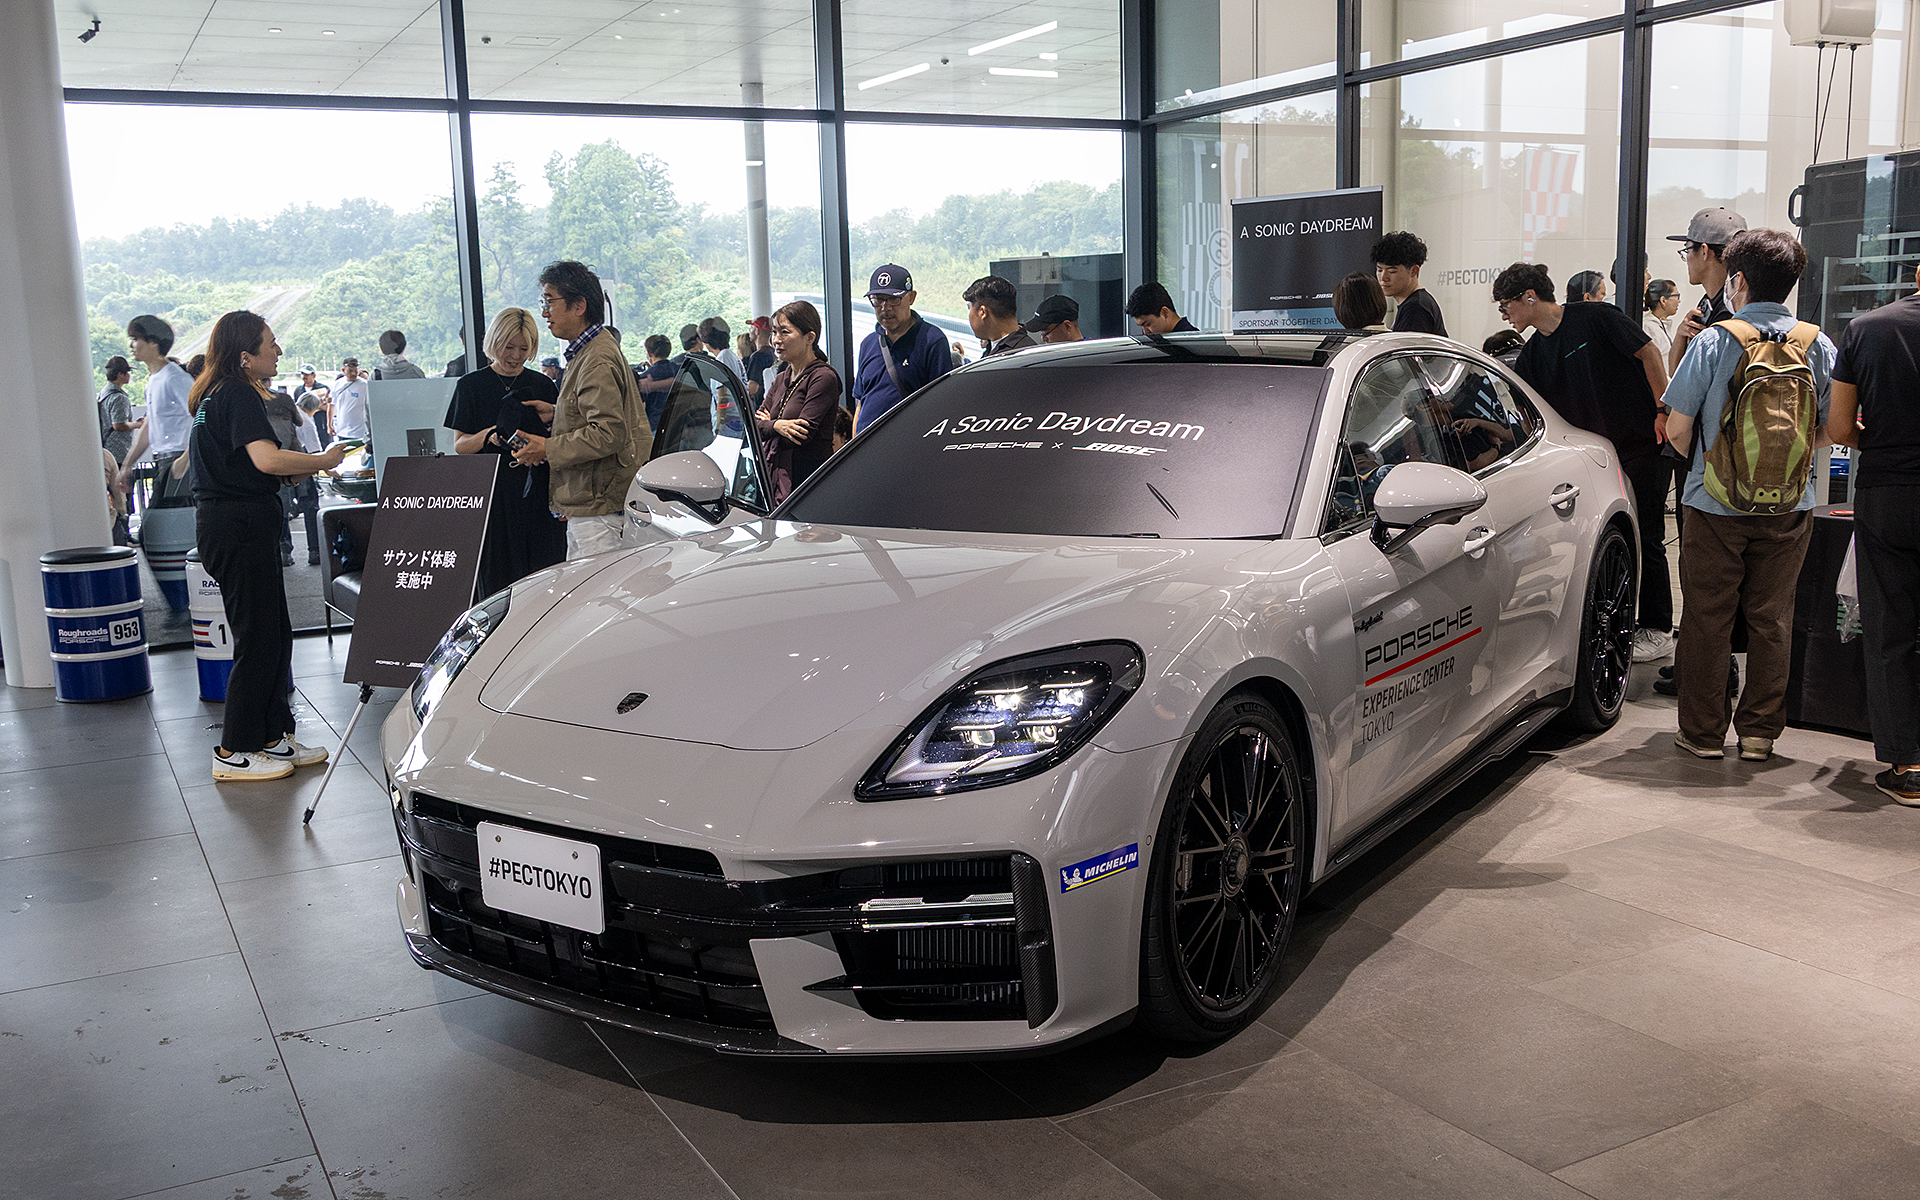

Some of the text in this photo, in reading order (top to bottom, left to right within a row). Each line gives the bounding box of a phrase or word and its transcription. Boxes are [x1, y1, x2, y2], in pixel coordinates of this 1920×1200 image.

[1240, 216, 1373, 238] A SONIC DAYDREAM
[1437, 267, 1506, 286] #PECTOK
[1282, 318, 1322, 326] TOGETHER
[923, 411, 1205, 441] A Sonic Daydream
[943, 441, 1044, 451] PORSCHE
[1073, 441, 1166, 456] BOSE
[382, 496, 484, 509] A SONIC DAYDREAM
[383, 550, 458, 568] サウンド体験
[202, 580, 220, 588] RAC
[395, 571, 433, 590] 実施中
[58, 620, 139, 640] Roughroads 953
[1365, 605, 1473, 672] PORSCHE
[1362, 656, 1455, 719] EXPERIENCE CENTER
[1361, 711, 1394, 745] TOKYO
[1084, 851, 1137, 879] MICHELIN
[488, 856, 592, 899] #PECTOKYO
